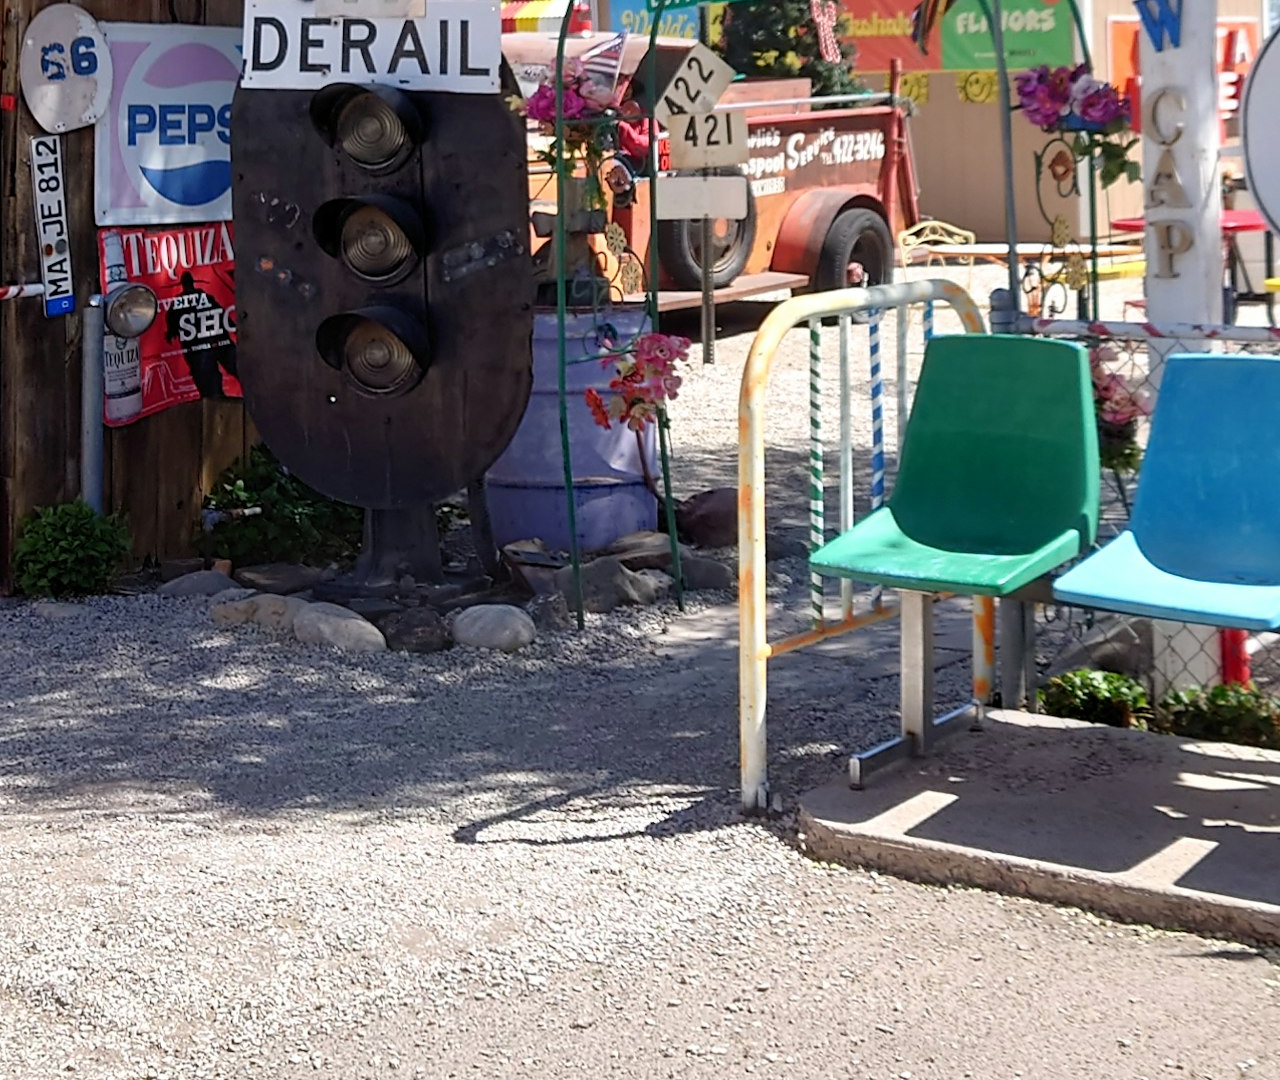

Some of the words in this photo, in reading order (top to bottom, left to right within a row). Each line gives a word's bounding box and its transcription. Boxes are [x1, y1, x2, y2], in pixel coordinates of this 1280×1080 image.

[251, 16, 490, 77] DERAIL
[664, 55, 714, 116] 422
[685, 113, 732, 147] 421
[832, 131, 886, 164] 422-3246
[35, 138, 61, 192] 812
[1145, 90, 1193, 280] CAP
[41, 200, 67, 238] JE
[48, 258, 70, 298] MA
[122, 222, 235, 280] TEQUIZA
